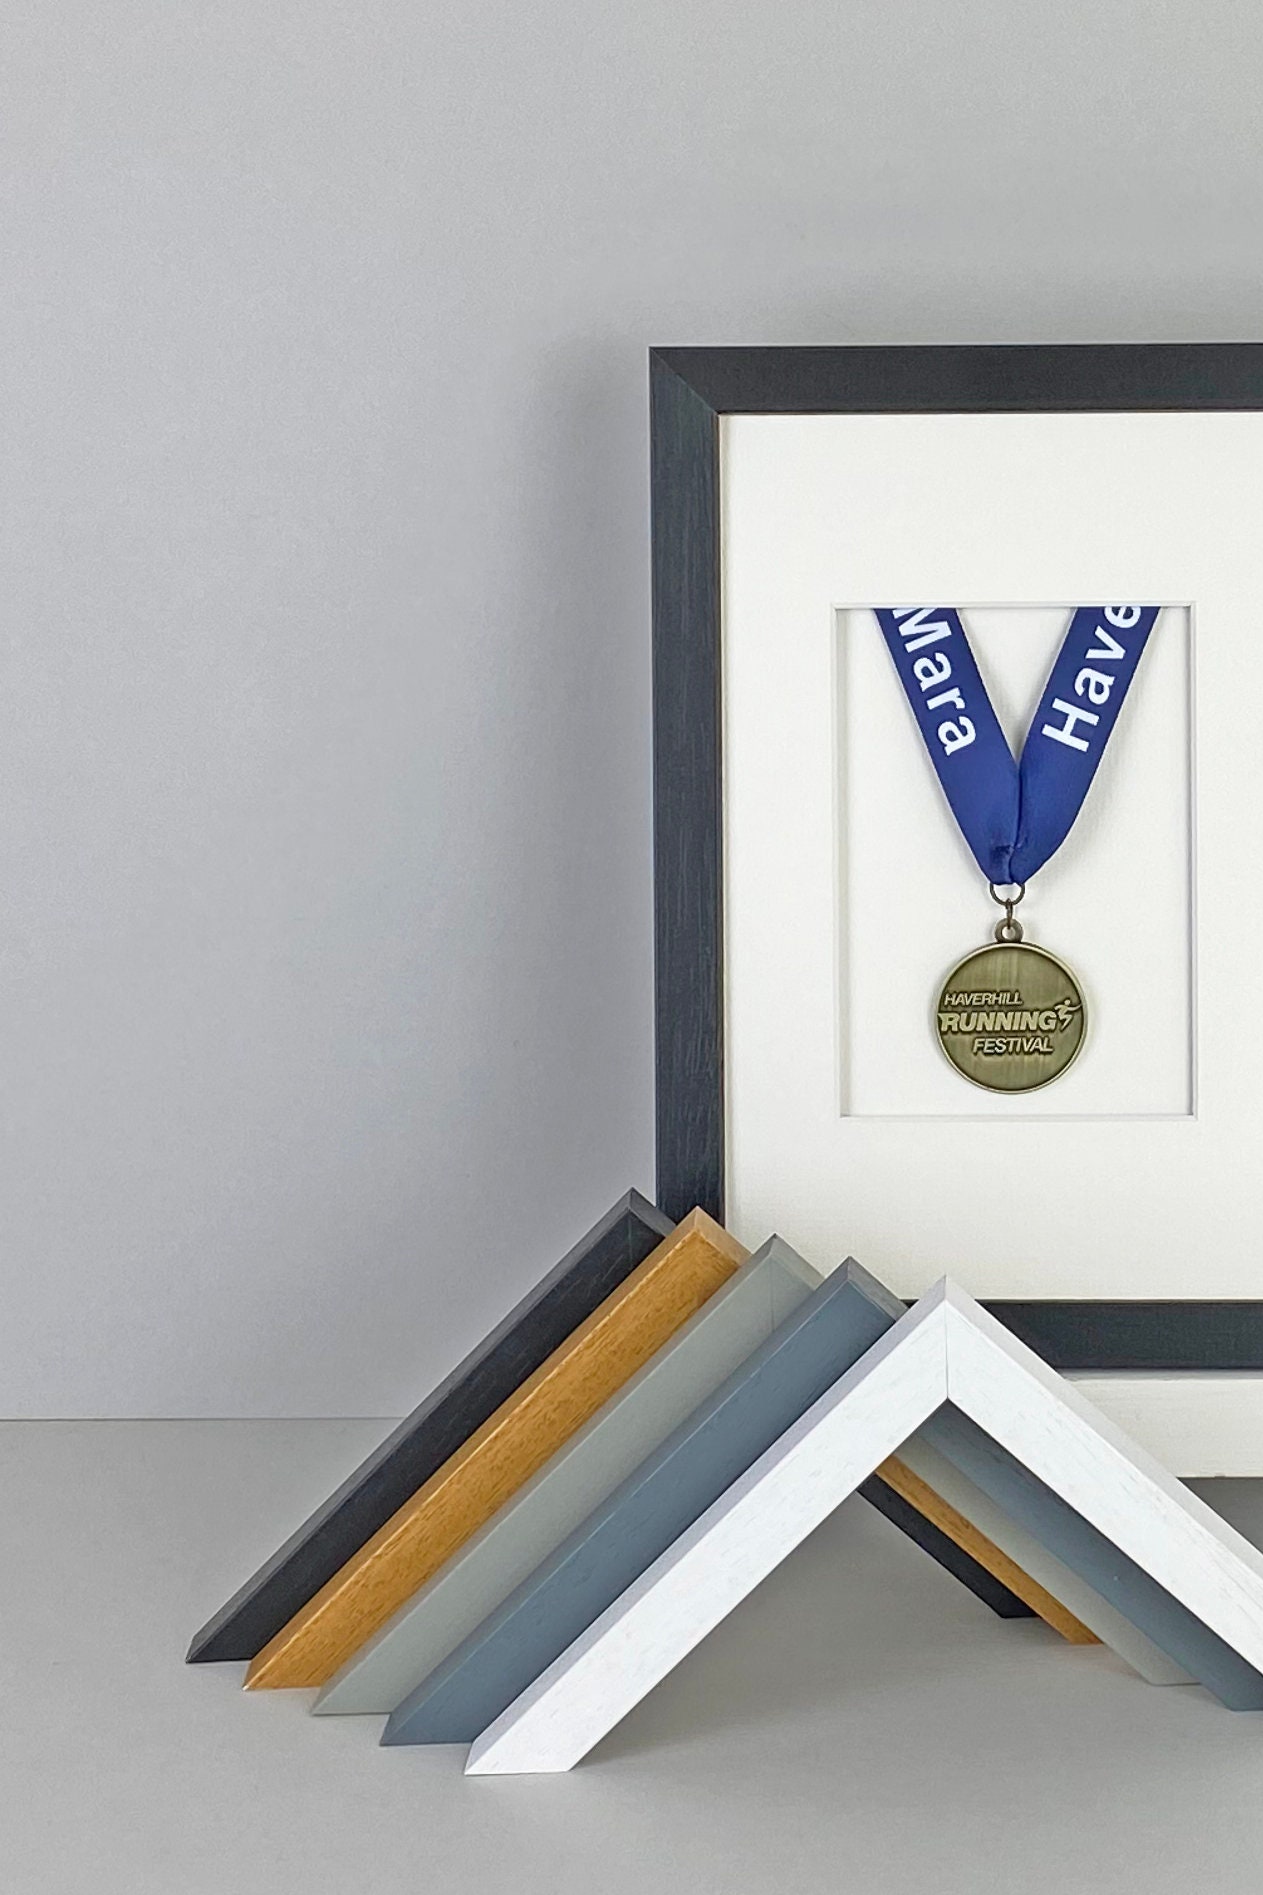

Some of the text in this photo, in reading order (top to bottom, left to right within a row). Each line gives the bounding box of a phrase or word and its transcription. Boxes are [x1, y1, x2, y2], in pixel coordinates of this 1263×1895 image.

[892, 607, 977, 756] Mara
[1041, 606, 1142, 752] Have
[943, 991, 1023, 1007] HAVERHILL
[938, 1010, 1058, 1033] RUNNING
[973, 1037, 1054, 1054] FESTIVAL
